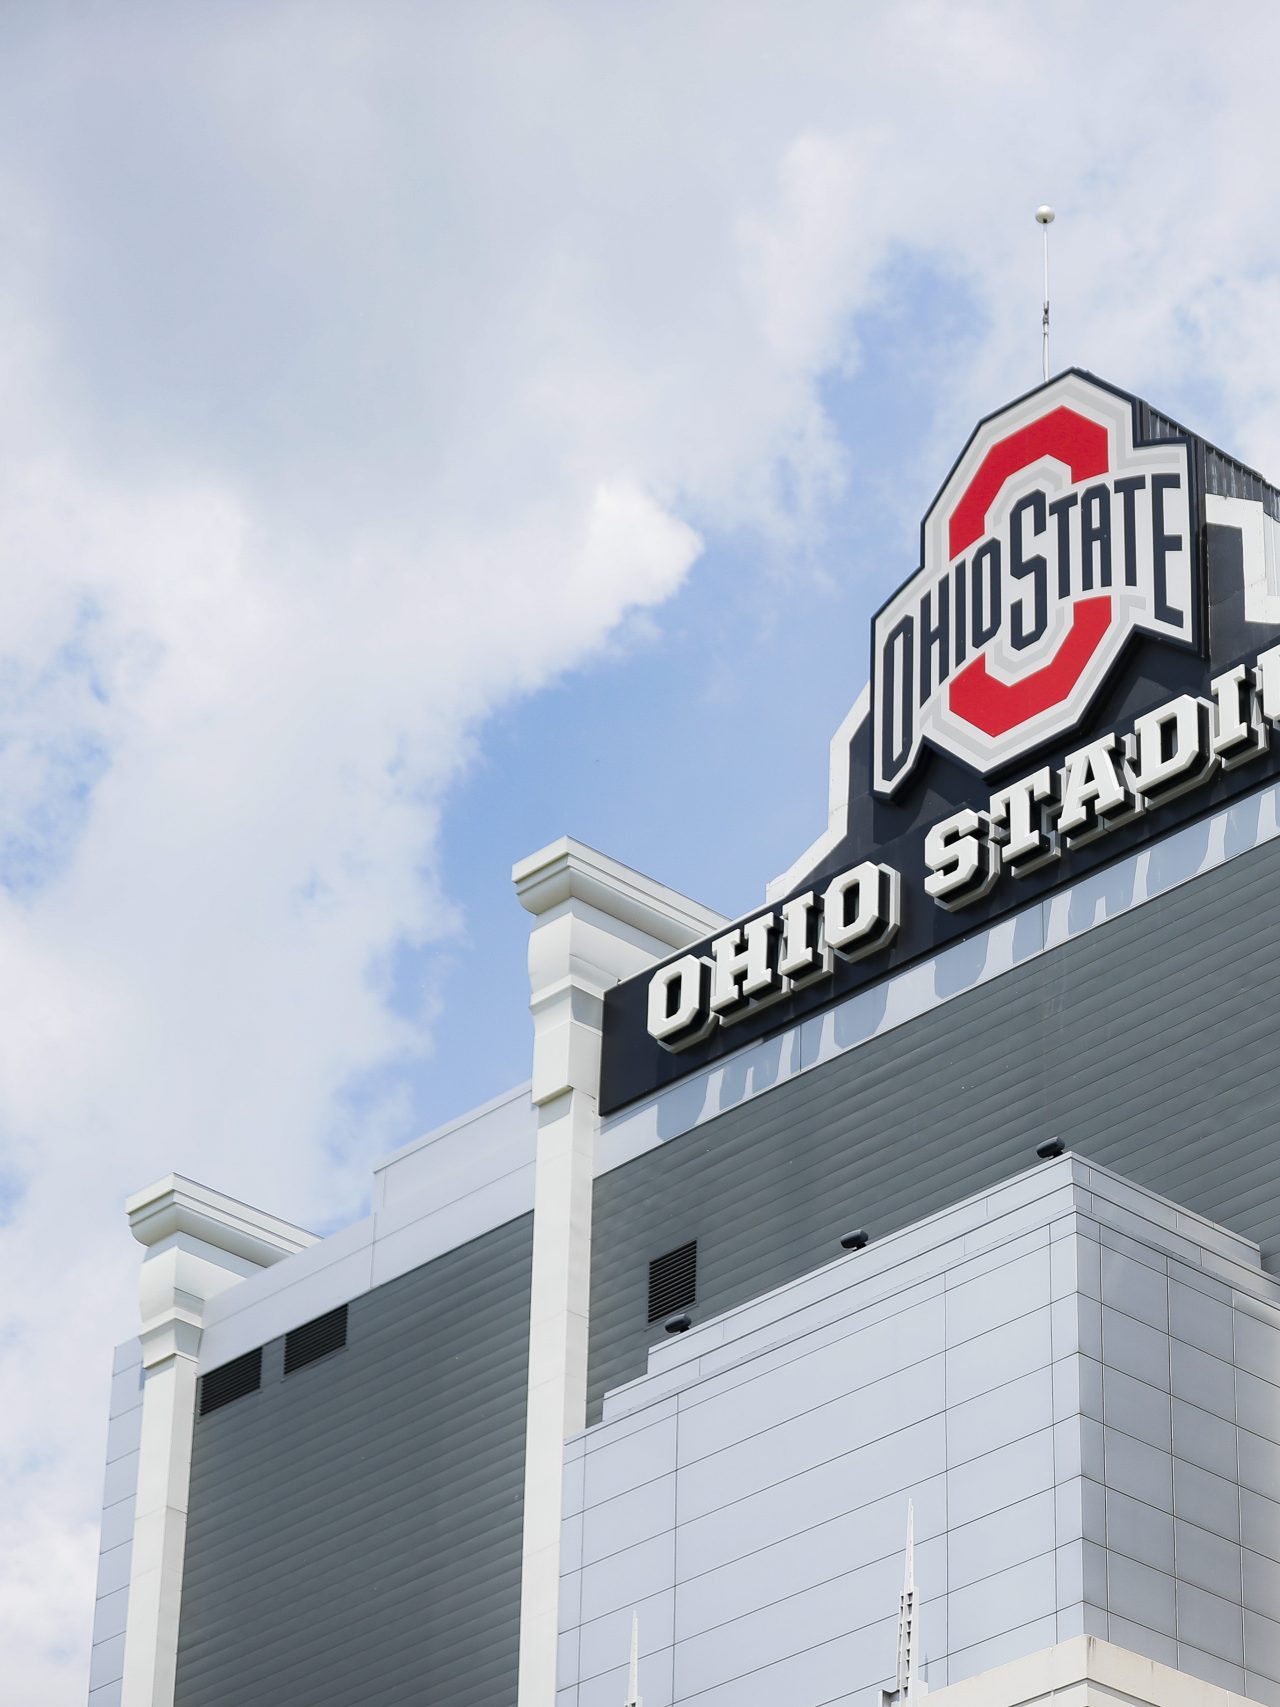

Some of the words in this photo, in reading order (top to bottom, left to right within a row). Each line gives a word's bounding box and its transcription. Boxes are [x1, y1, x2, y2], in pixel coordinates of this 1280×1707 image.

[882, 537, 1001, 782] OHIO
[1009, 473, 1184, 652] STATE
[647, 861, 900, 1051] OHIO
